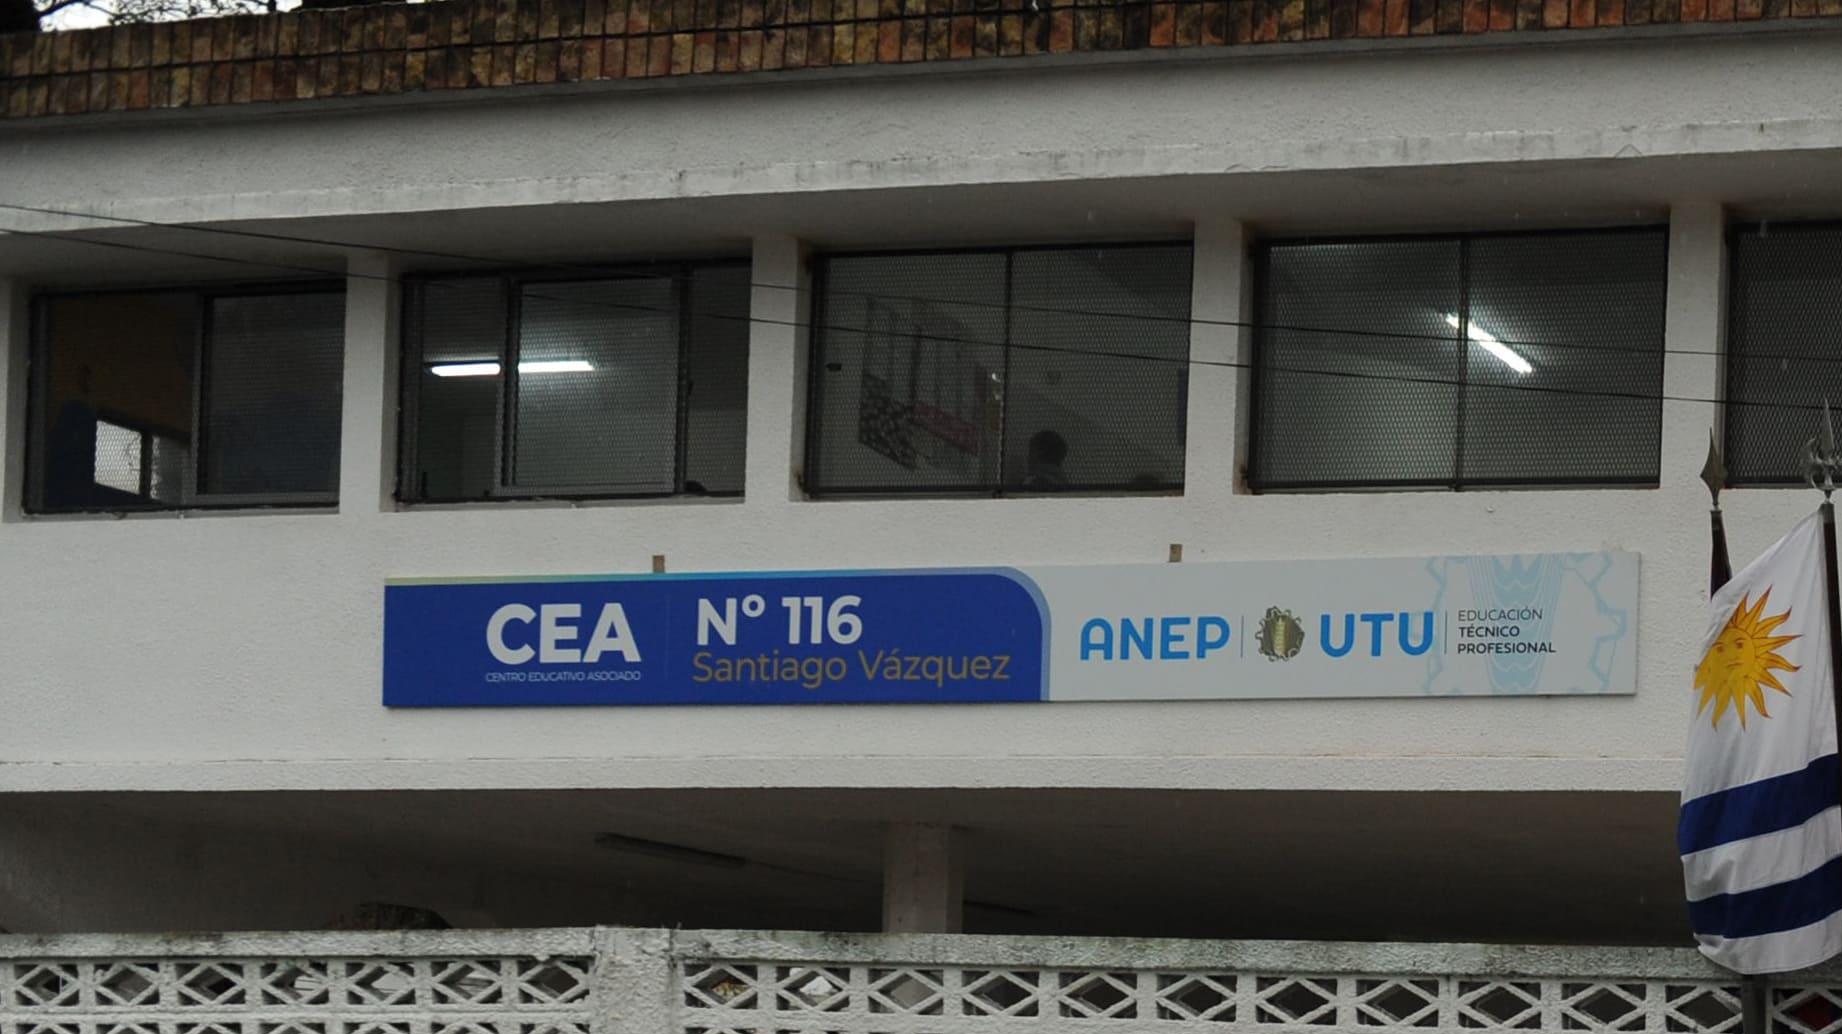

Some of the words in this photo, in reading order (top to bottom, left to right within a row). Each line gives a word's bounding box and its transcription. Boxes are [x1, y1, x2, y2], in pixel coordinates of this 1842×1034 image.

[781, 594, 863, 645] 116
[1457, 605, 1544, 624] EDUCACIÓN
[486, 602, 642, 666] CEA
[1080, 614, 1231, 661] ANEP
[1318, 609, 1435, 658] UTU
[1457, 623, 1521, 640] TÉCNICO
[1456, 640, 1557, 656] PROFESIONAL
[486, 672, 527, 683] CENTRO
[527, 671, 585, 682] EDUCATIVO
[587, 670, 642, 682] ASOCIADO
[692, 650, 847, 689] Santiago
[857, 648, 1011, 688] Vázquez
